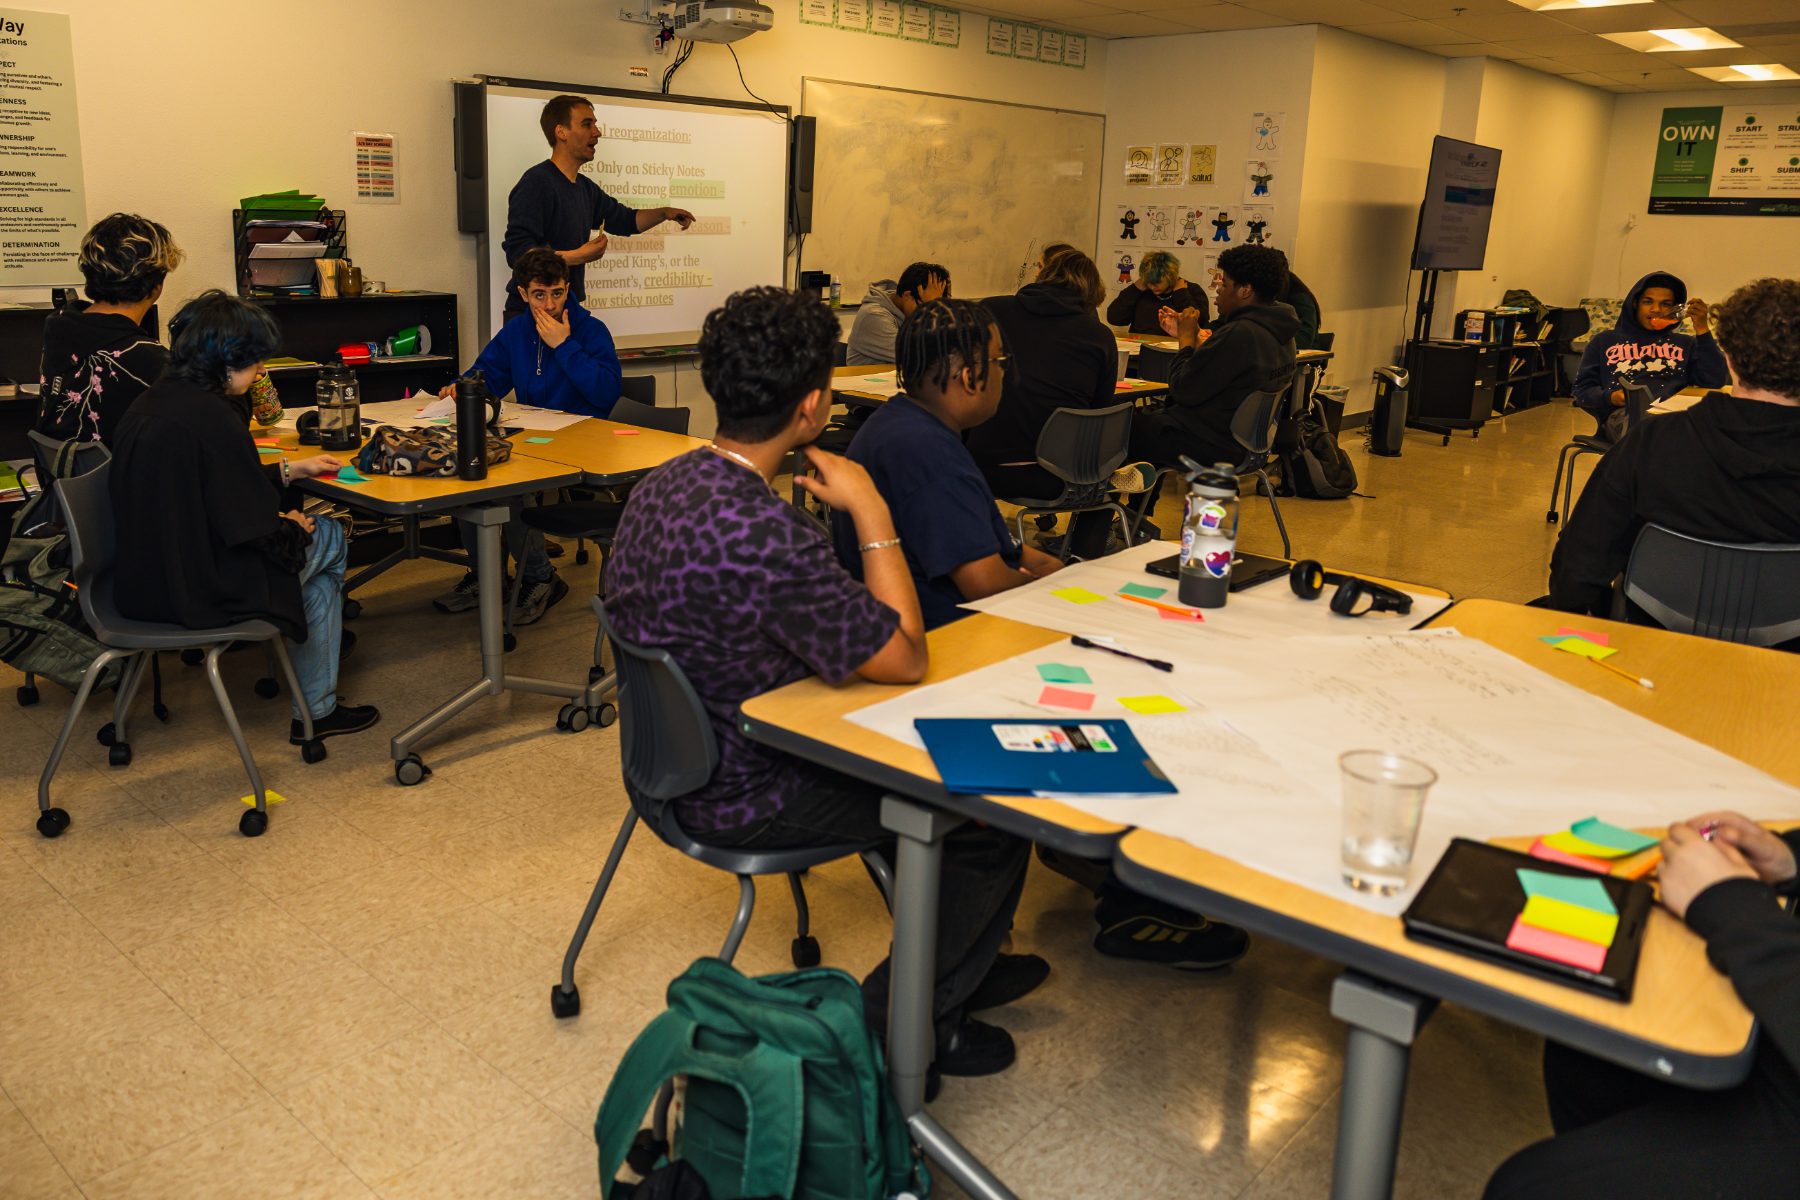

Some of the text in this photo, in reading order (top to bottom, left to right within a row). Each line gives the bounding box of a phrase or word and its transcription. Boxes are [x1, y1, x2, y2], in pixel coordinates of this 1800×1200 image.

[0, 18, 24, 36] ay
[1663, 125, 1716, 141] OWN
[1676, 141, 1698, 156] IT
[596, 160, 623, 177] Only
[625, 164, 640, 175] on
[641, 162, 674, 180] Sticky
[677, 164, 705, 177] Notes
[1191, 173, 1212, 182] salud
[632, 183, 667, 199] strong
[669, 182, 717, 196] emotion
[637, 239, 664, 251] notes
[631, 254, 668, 271] King's,
[670, 257, 681, 267] or
[683, 254, 700, 267] the
[644, 271, 704, 288] credibility
[610, 293, 643, 307] sticky
[646, 293, 674, 305] notes
[1605, 342, 1684, 366] Atlanta
